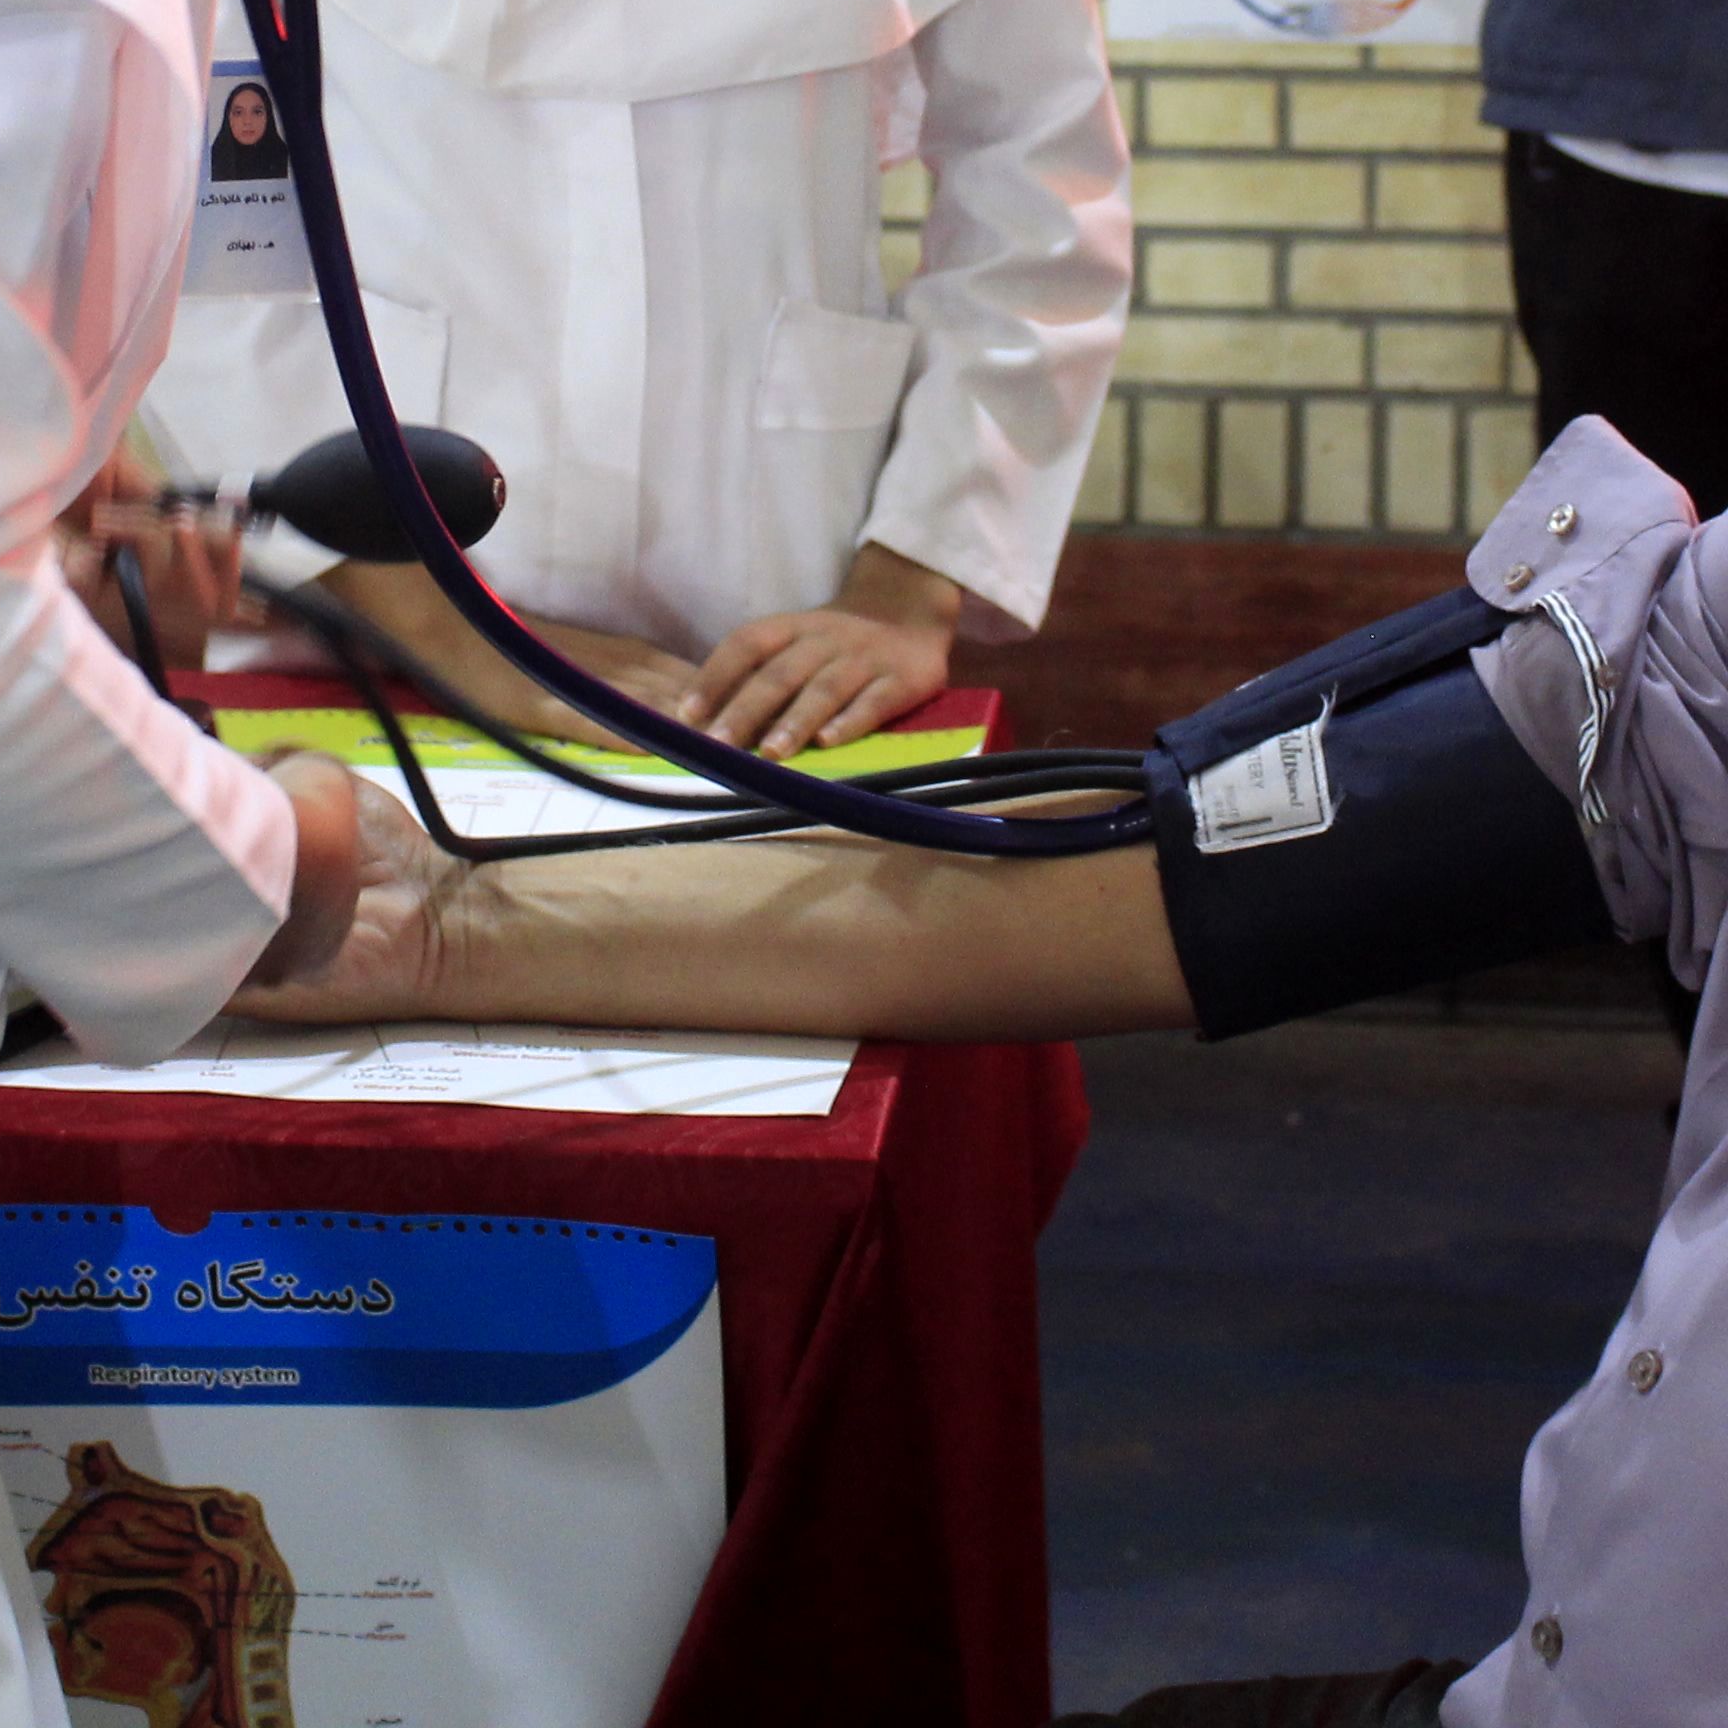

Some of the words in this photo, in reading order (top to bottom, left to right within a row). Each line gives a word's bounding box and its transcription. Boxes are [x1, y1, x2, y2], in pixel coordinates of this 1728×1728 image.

[175, 1258, 395, 1317] دستگاه
[88, 1363, 216, 1389] Respiratory
[220, 1367, 300, 1389] system
